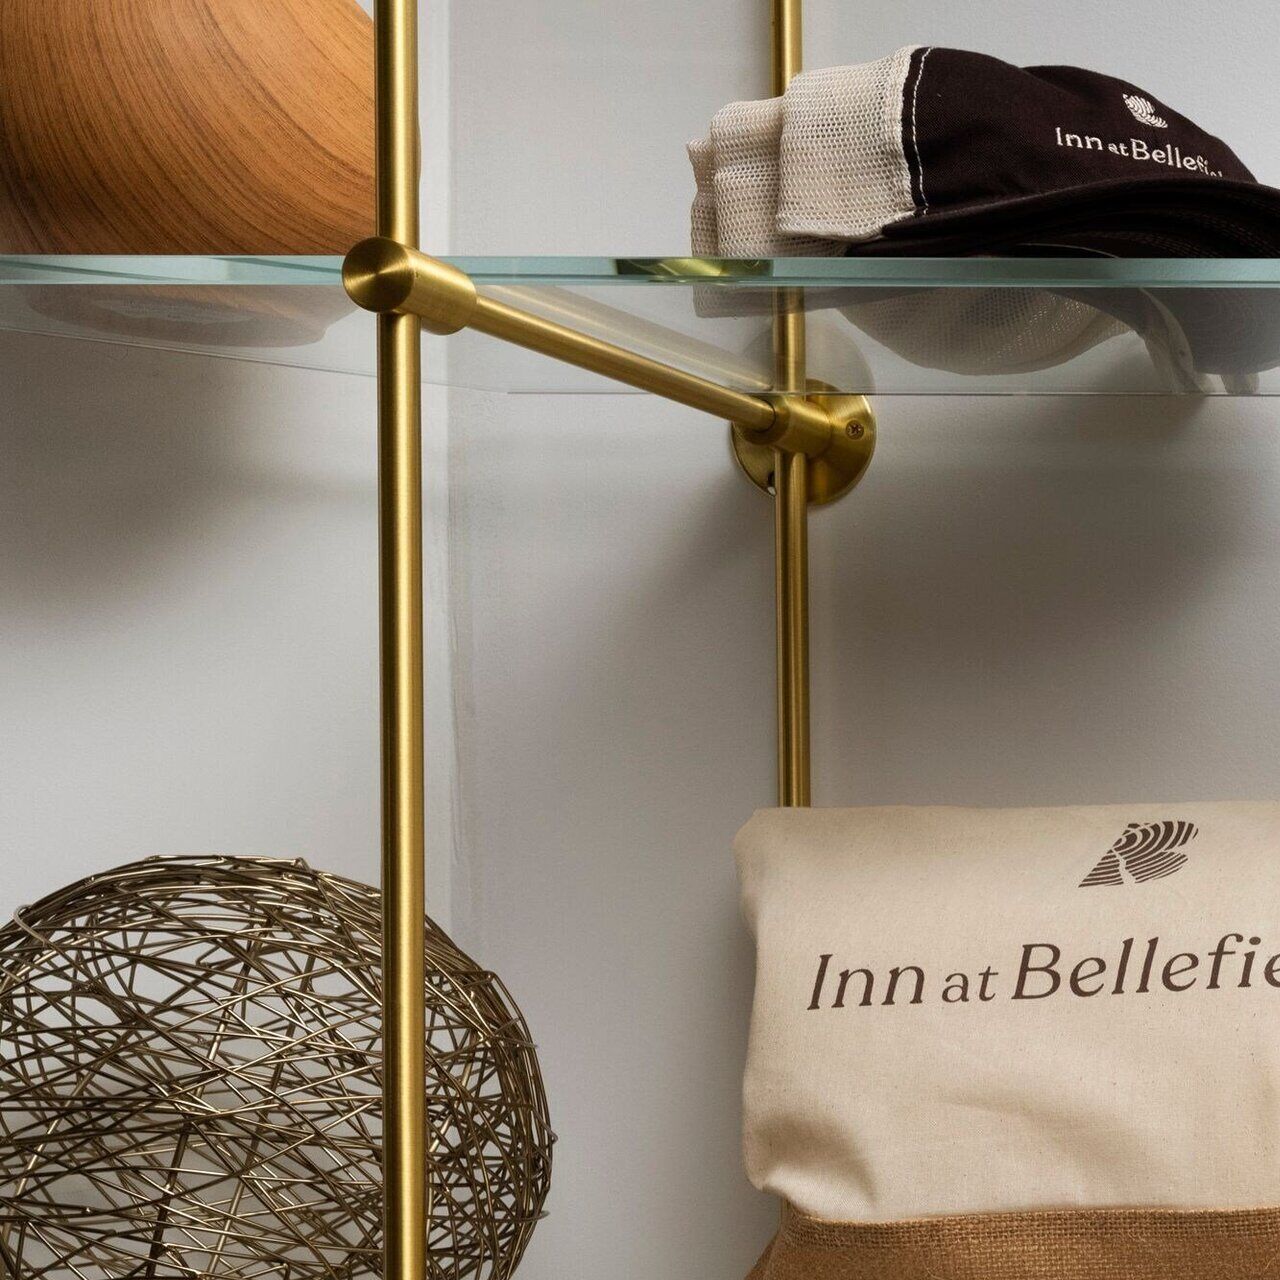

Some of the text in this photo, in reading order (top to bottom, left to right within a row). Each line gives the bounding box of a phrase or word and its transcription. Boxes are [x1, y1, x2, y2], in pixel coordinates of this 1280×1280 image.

[1055, 127, 1103, 150] Inn
[1108, 142, 1129, 157] at
[807, 954, 927, 1010] Inn
[941, 965, 999, 1003] at
